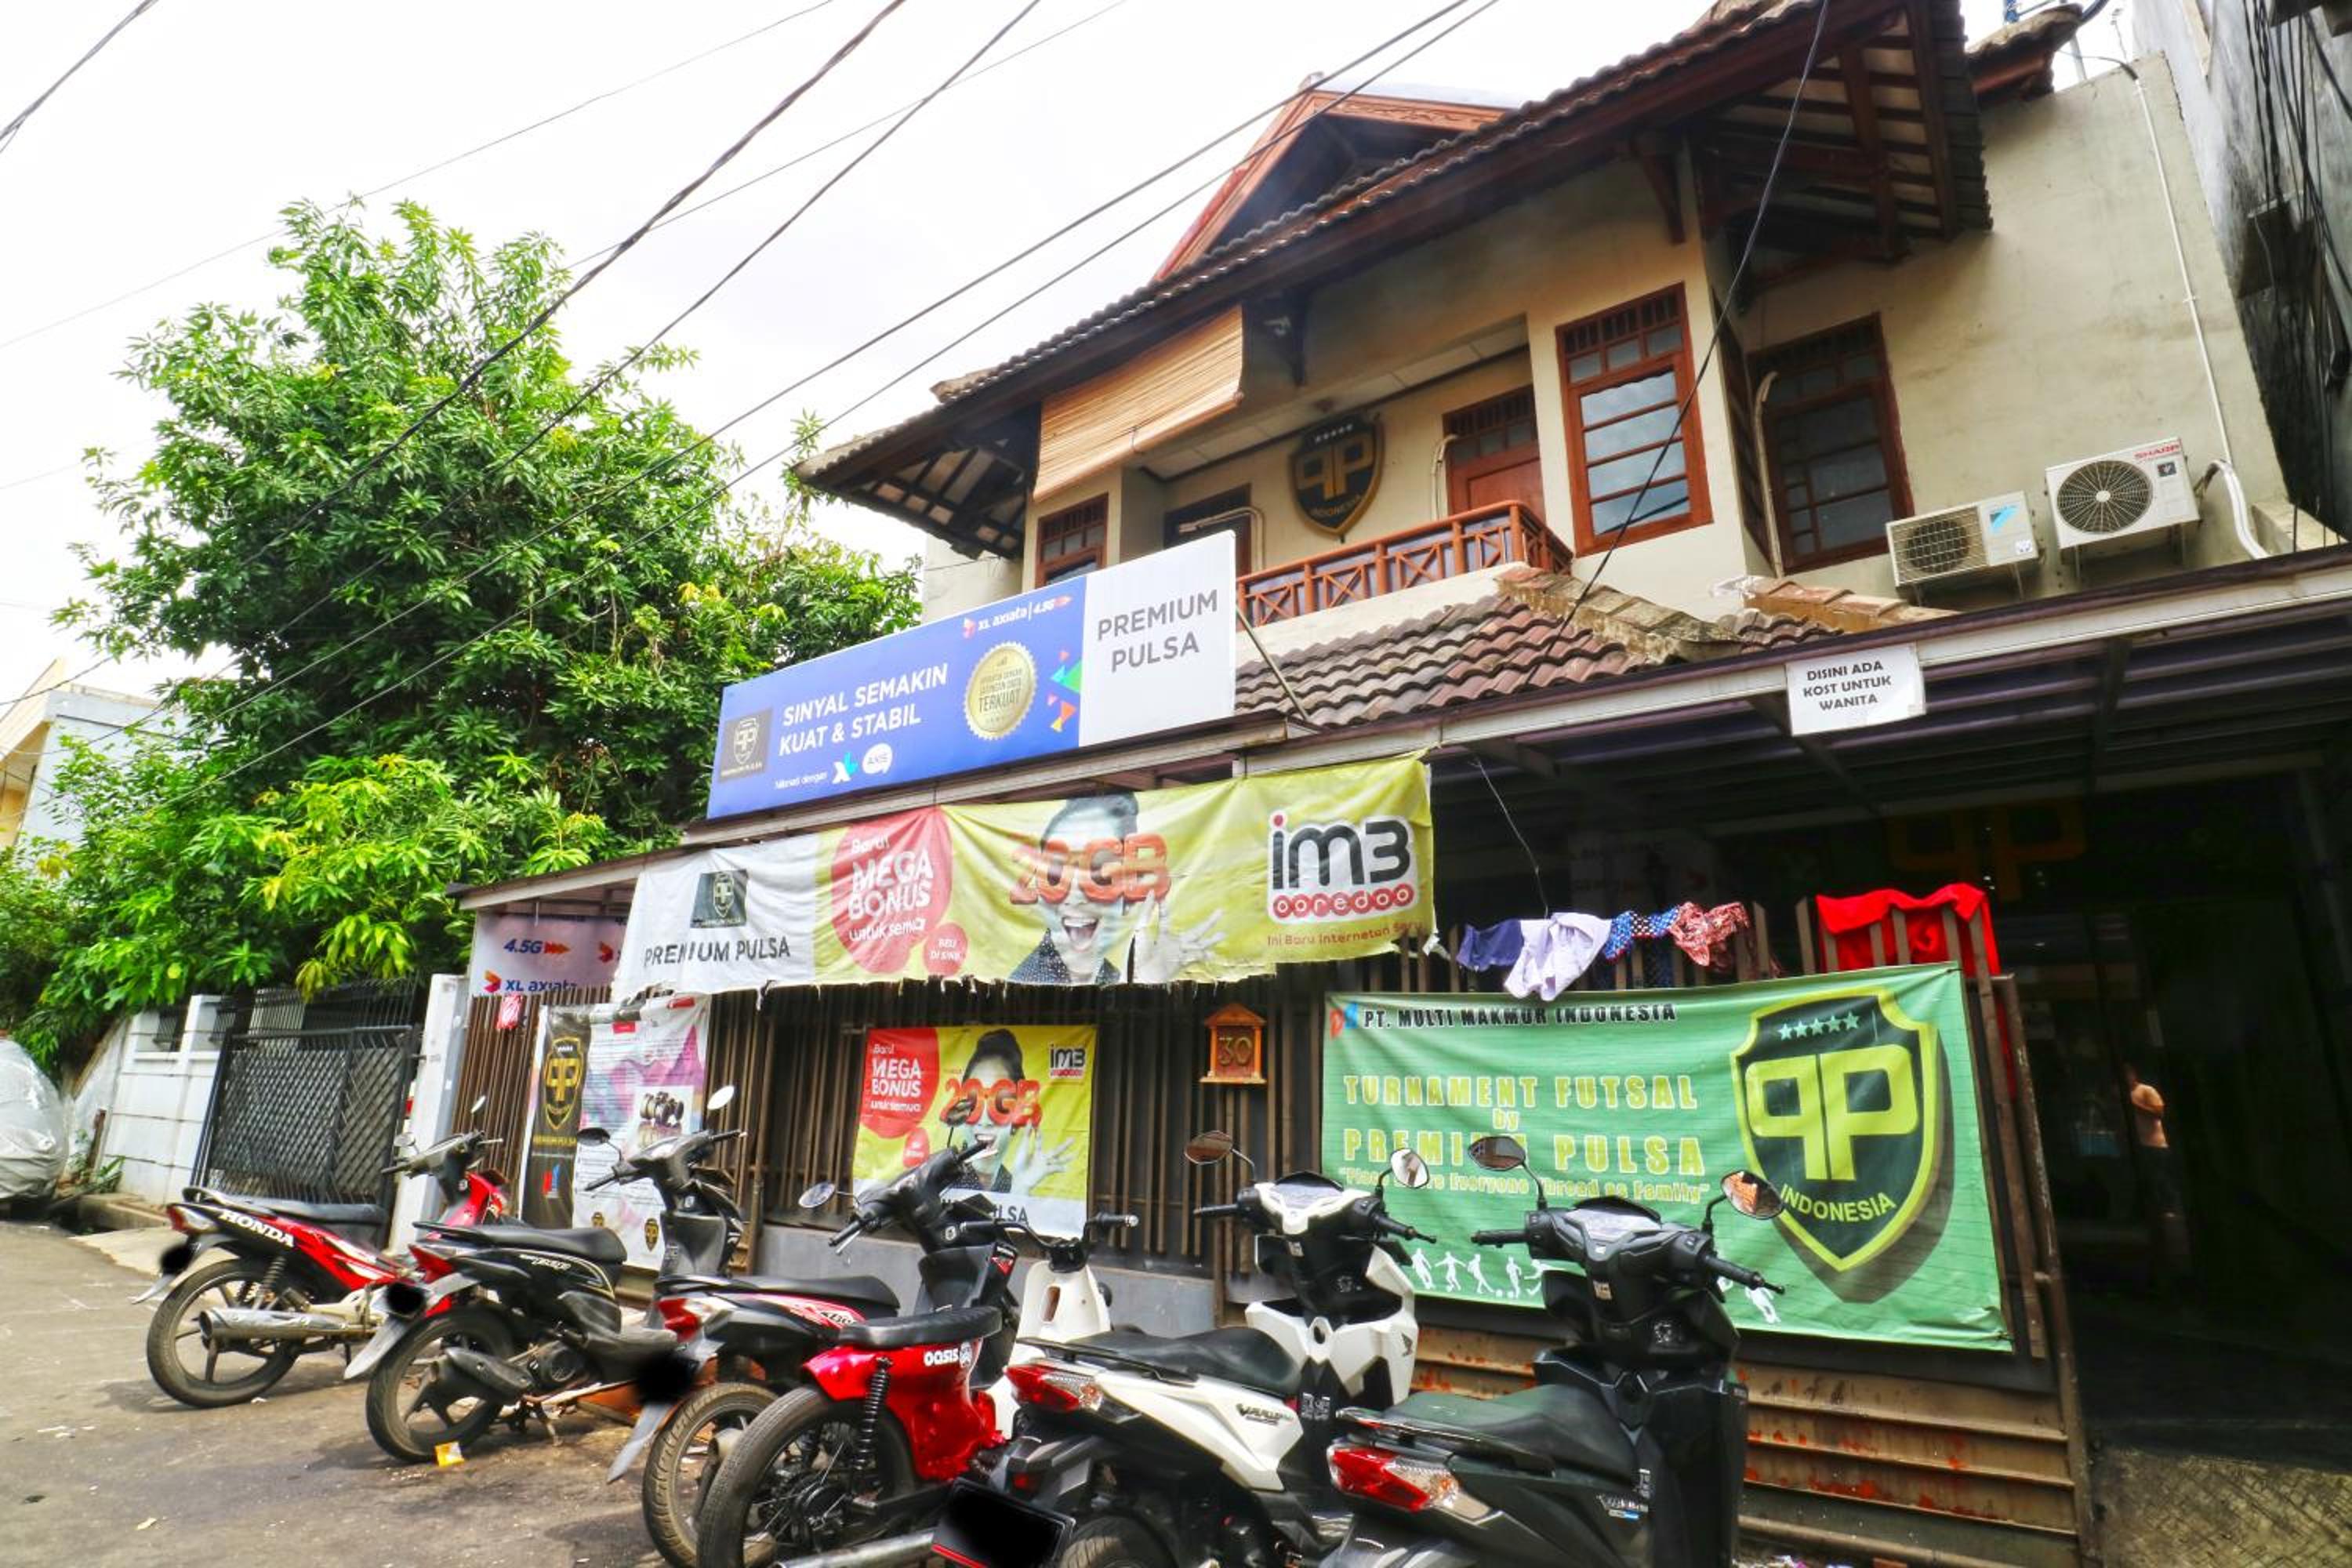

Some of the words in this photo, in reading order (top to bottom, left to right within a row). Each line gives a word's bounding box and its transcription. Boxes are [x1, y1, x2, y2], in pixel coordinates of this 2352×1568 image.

[2135, 445, 2180, 459] SHARP
[1098, 589, 1218, 641] PREMIUM
[1112, 631, 1200, 673] PULSA
[1806, 666, 1848, 681] DISINI
[1851, 660, 1884, 675] ADA
[782, 691, 849, 726] SINYAL
[854, 662, 948, 708] SEMAKIN
[1803, 683, 1838, 698] KOST
[1842, 675, 1892, 692] UNTUK
[1819, 694, 1878, 711] WANITA
[779, 725, 828, 757] KUAT
[831, 722, 845, 743] &
[851, 703, 921, 739] STABIL
[852, 848, 934, 891] MEGA
[848, 879, 931, 920] BONUS
[1276, 887, 1410, 914] ooredoo
[503, 938, 543, 954] 4.5G
[735, 935, 790, 961] PULSA
[505, 980, 524, 992] XL
[1364, 1010, 1391, 1028] PT.
[1398, 1009, 1455, 1028] MULTI
[1461, 1007, 1548, 1026] MAKMUR
[1555, 1004, 1676, 1023] INDONESIA
[872, 1058, 922, 1080] MEGA
[871, 1079, 922, 1098] BONUS
[1344, 1075, 1537, 1109] TURNAMENT
[1555, 1075, 1697, 1109] FUTSAL
[1493, 1108, 1519, 1131] by
[1553, 1134, 1705, 1176] PULSA
[1780, 1183, 1897, 1223] INDONESIA
[218, 1208, 295, 1247] HONDA
